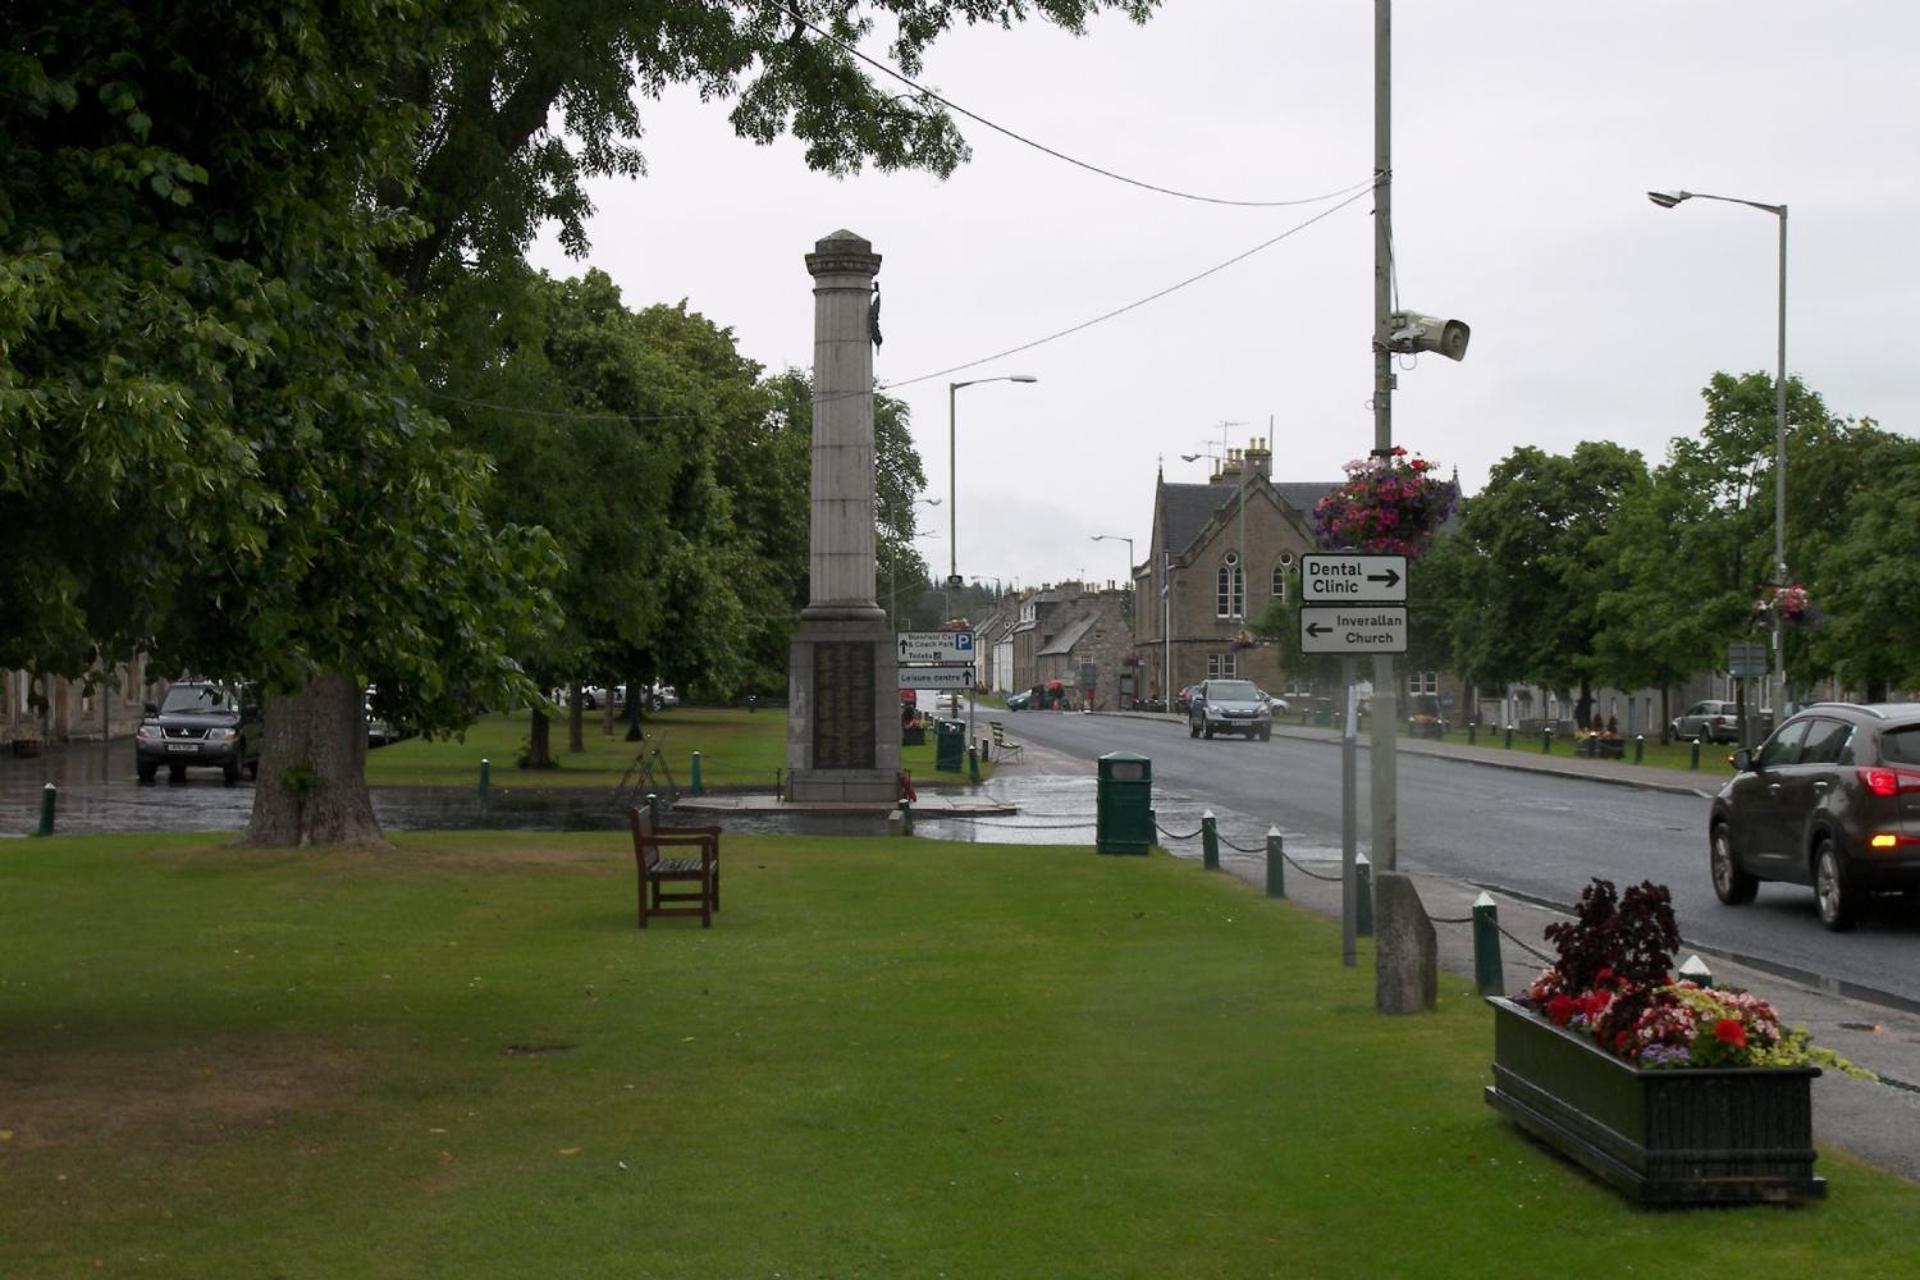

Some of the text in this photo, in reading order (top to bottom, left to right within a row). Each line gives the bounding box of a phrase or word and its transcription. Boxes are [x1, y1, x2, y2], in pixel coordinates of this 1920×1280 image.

[1310, 562, 1362, 576] Dental
[1313, 579, 1359, 593] Clinic
[1336, 615, 1402, 626] Inverallan
[958, 634, 970, 649] P
[1346, 632, 1394, 643] Church
